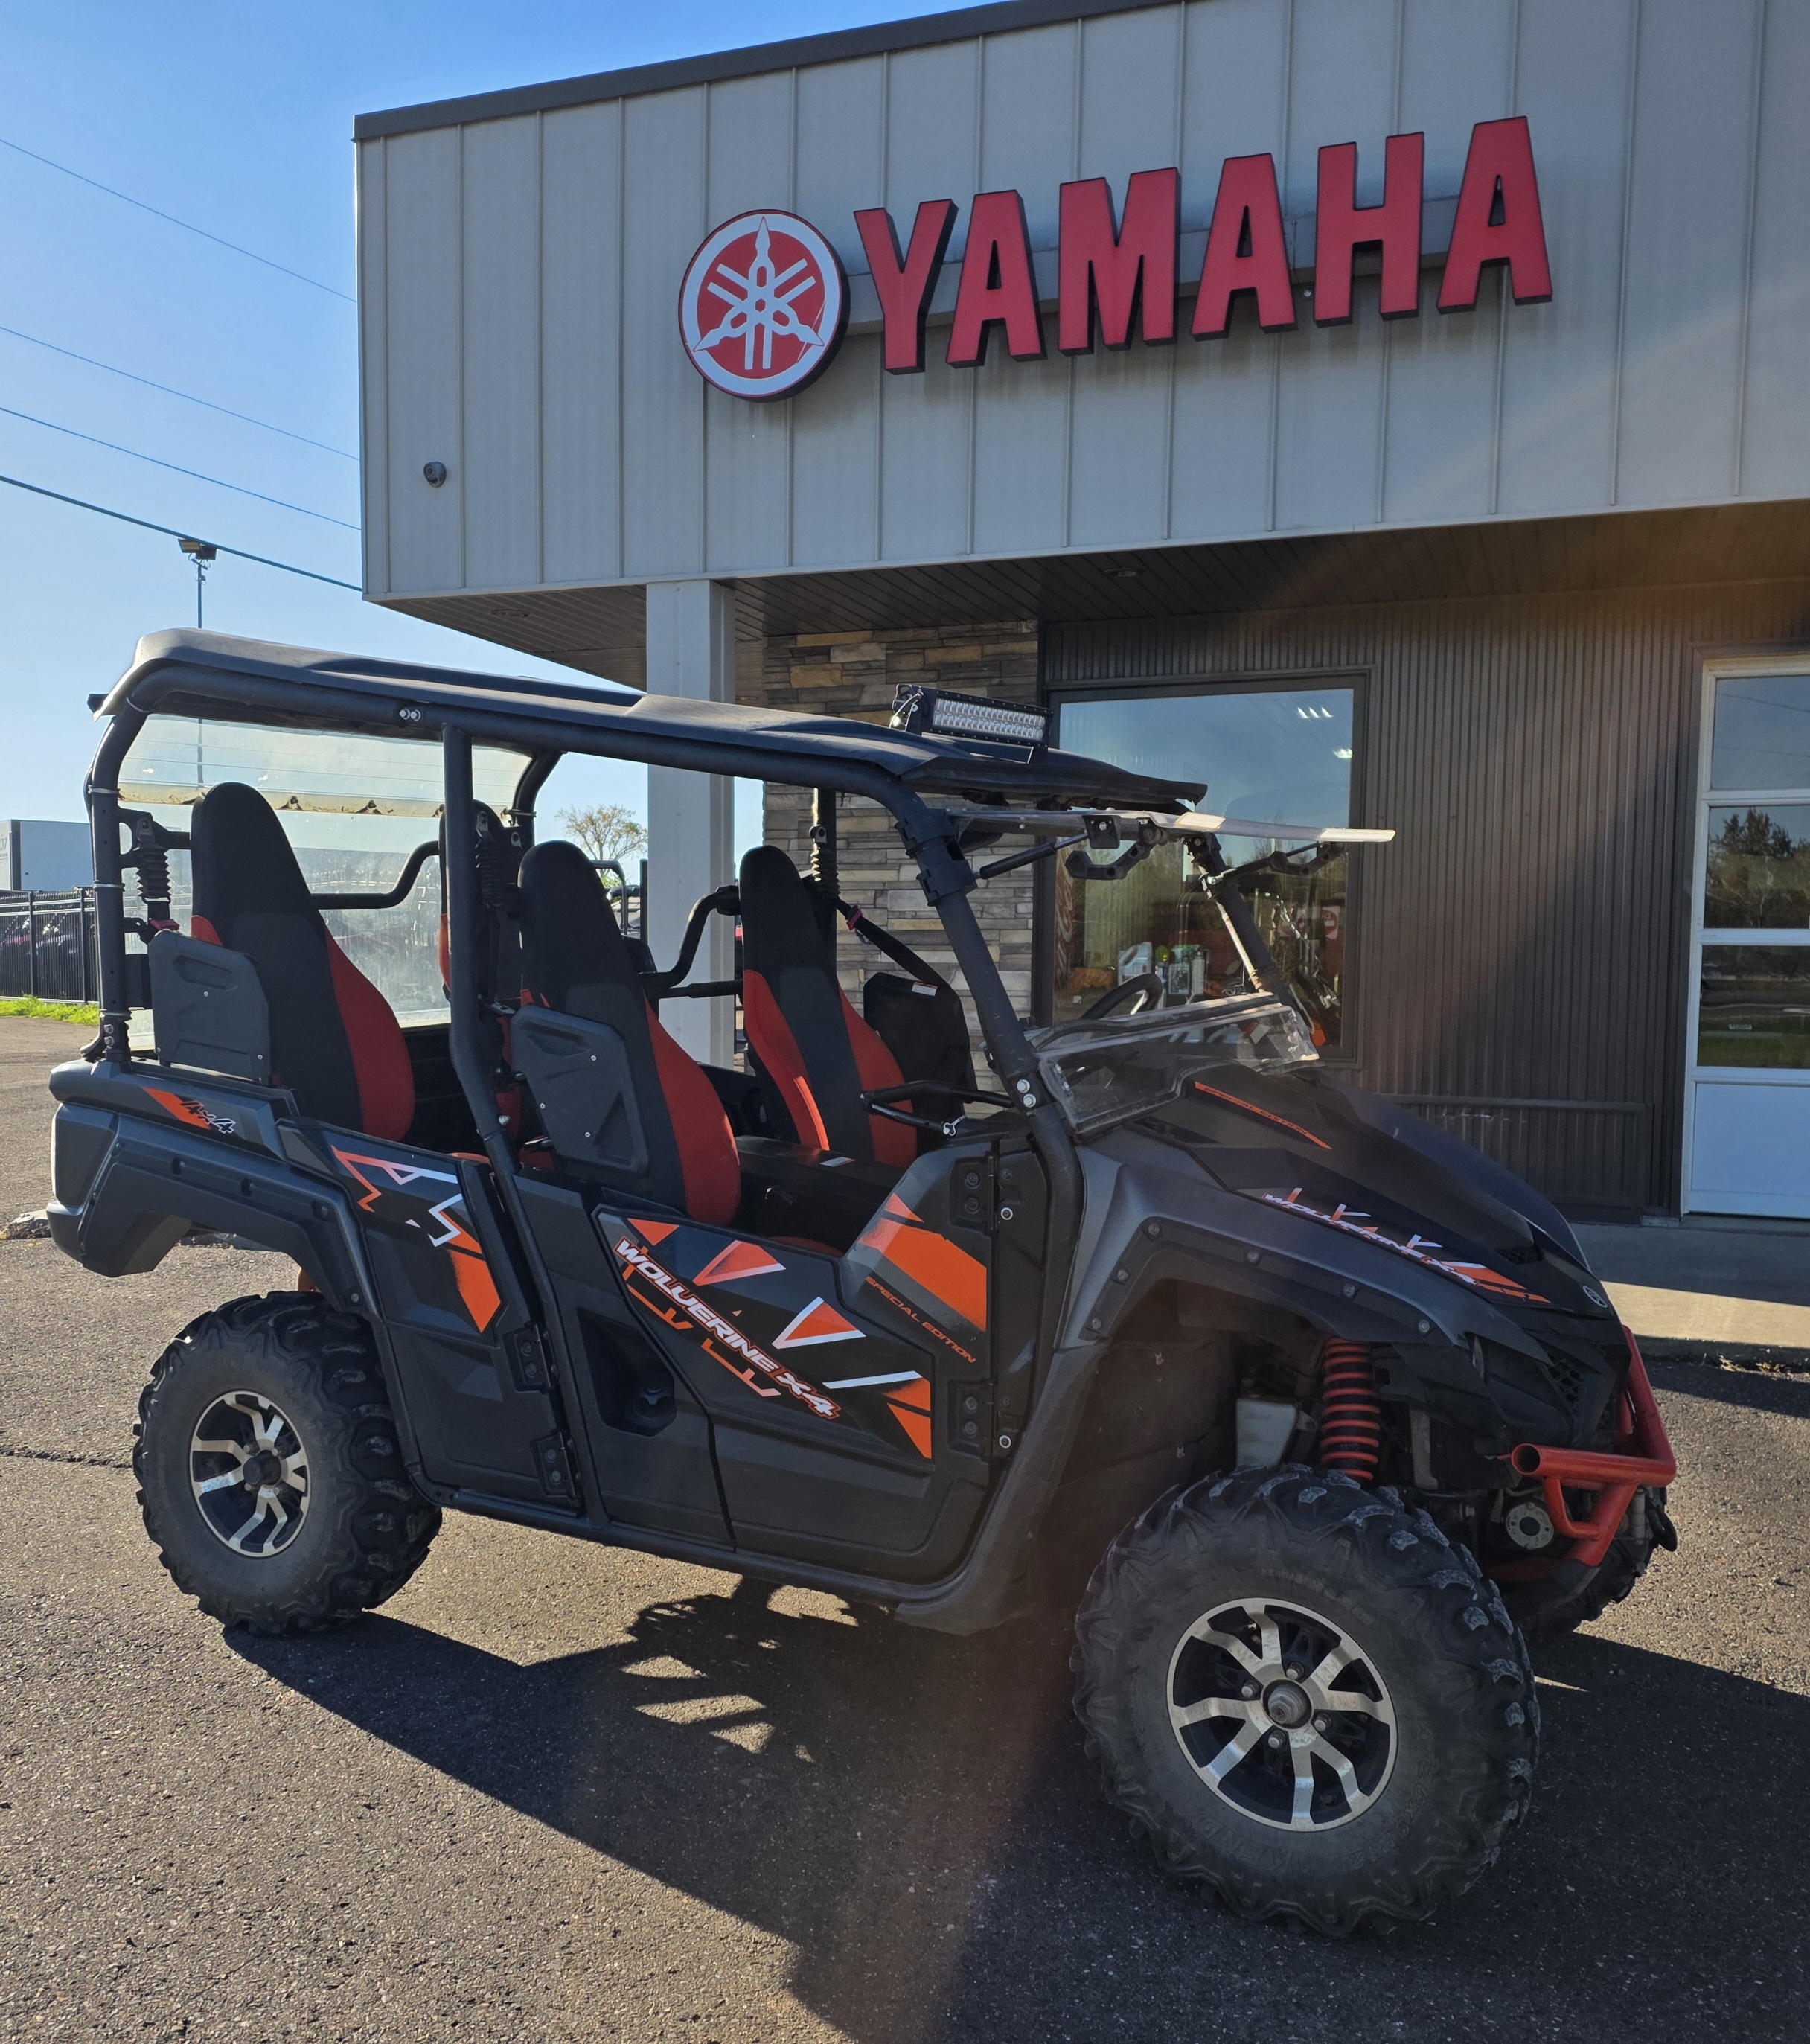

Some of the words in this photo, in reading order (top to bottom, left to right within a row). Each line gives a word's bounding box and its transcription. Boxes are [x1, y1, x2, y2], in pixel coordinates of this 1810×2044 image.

[853, 116, 1553, 374] YAMAHA
[1263, 1192, 1429, 1259] WOLVERINE
[614, 1237, 783, 1374] WOLVERINE
[865, 1276, 920, 1322] SPECIAL
[921, 1321, 976, 1363] EDITION
